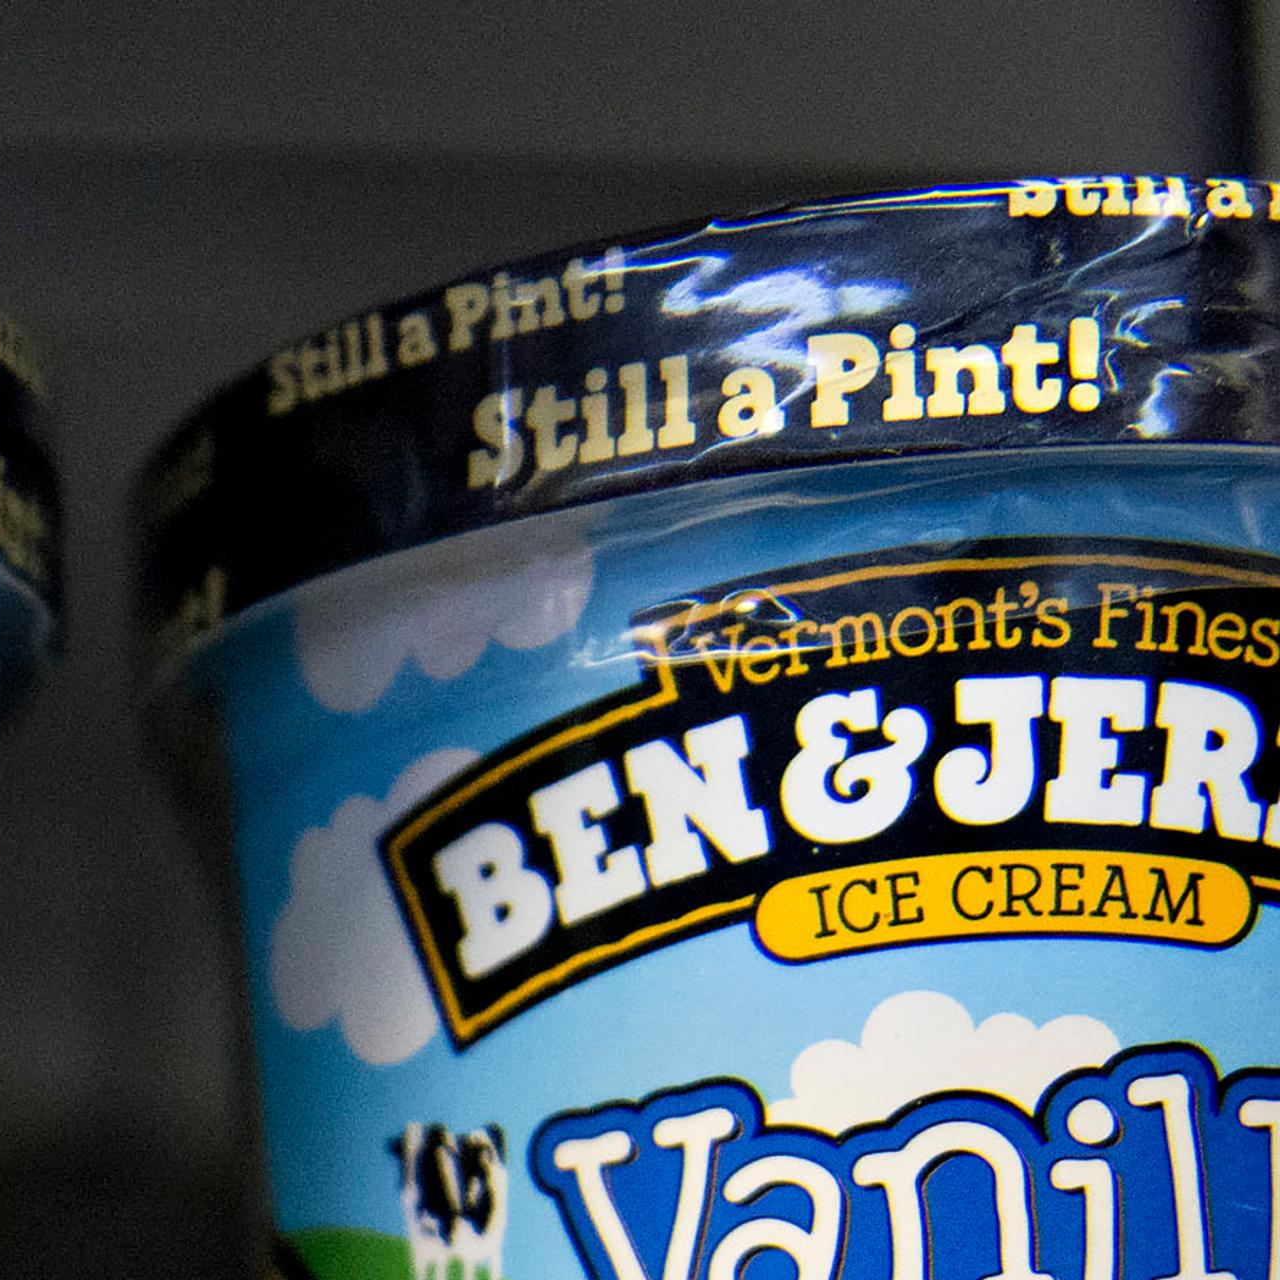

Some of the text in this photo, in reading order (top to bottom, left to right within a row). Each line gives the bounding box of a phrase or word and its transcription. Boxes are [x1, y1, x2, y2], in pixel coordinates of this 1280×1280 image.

[267, 245, 626, 417] Still a Pint!
[467, 316, 1102, 490] Still a Pint!
[692, 584, 1280, 694] Vermont's Fines
[433, 674, 1280, 982] BEN & JER
[809, 863, 1207, 940] ICE CREAM
